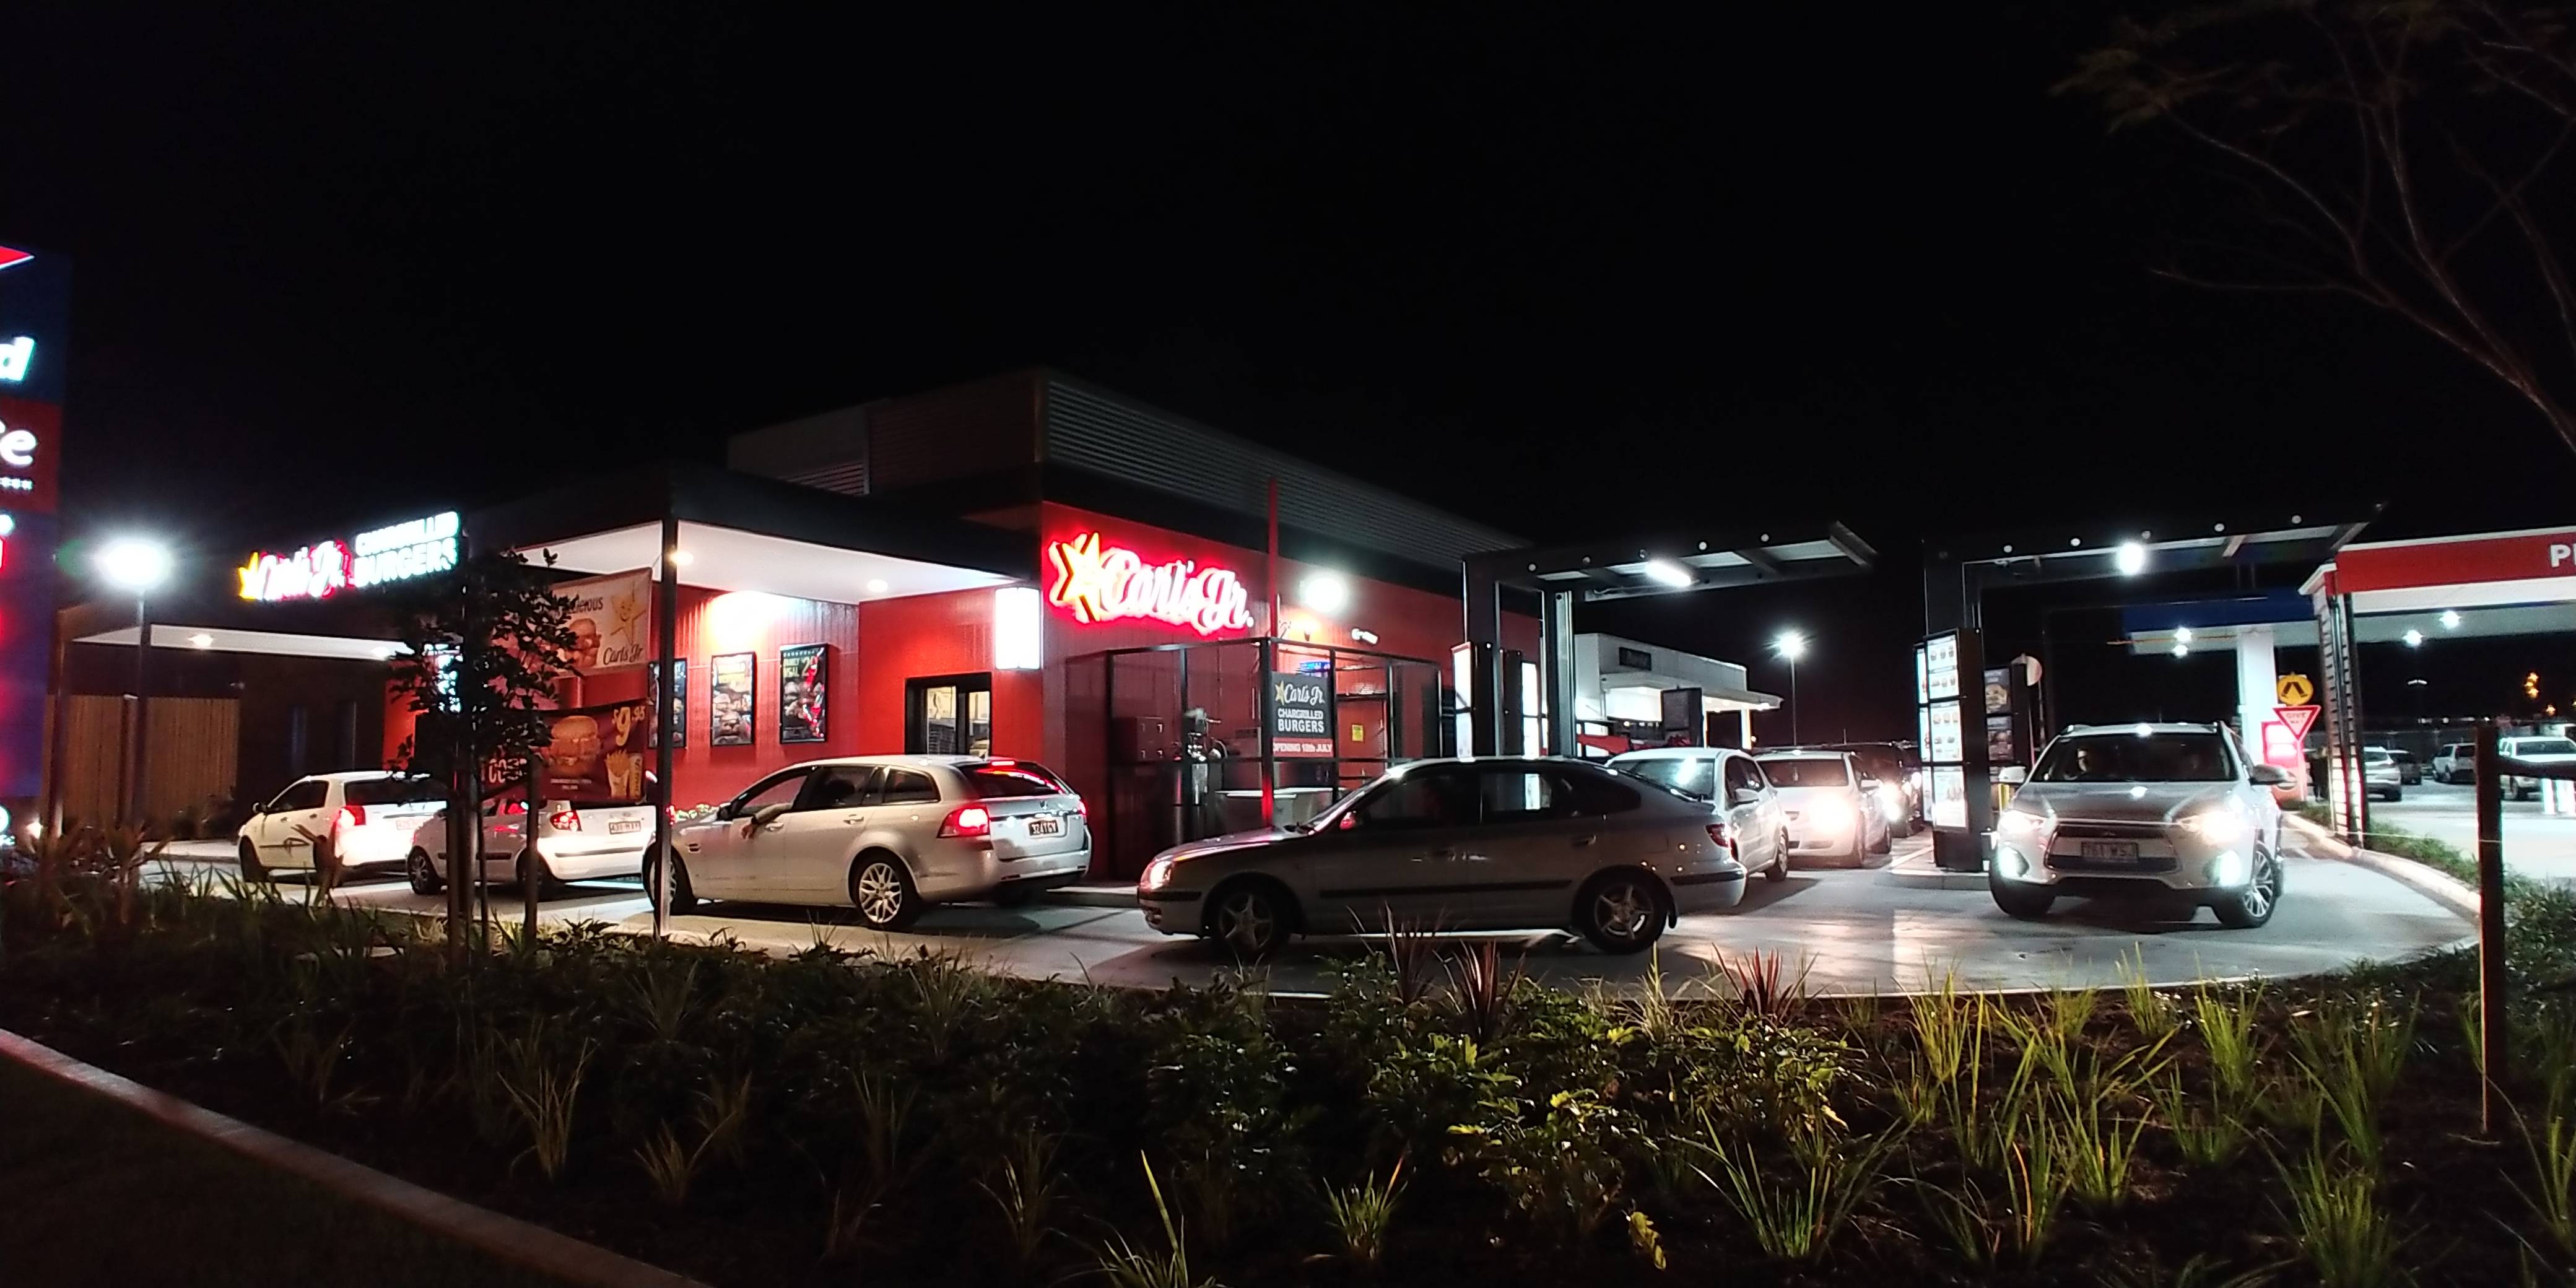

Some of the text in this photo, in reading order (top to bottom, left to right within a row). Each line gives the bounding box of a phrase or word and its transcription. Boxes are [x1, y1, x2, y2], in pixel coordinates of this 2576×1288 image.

[354, 537, 457, 588] BURGERS
[1277, 708, 1324, 720] CHARGRILLED
[1277, 718, 1325, 733] BURGERS
[1315, 744, 1331, 753] JULY
